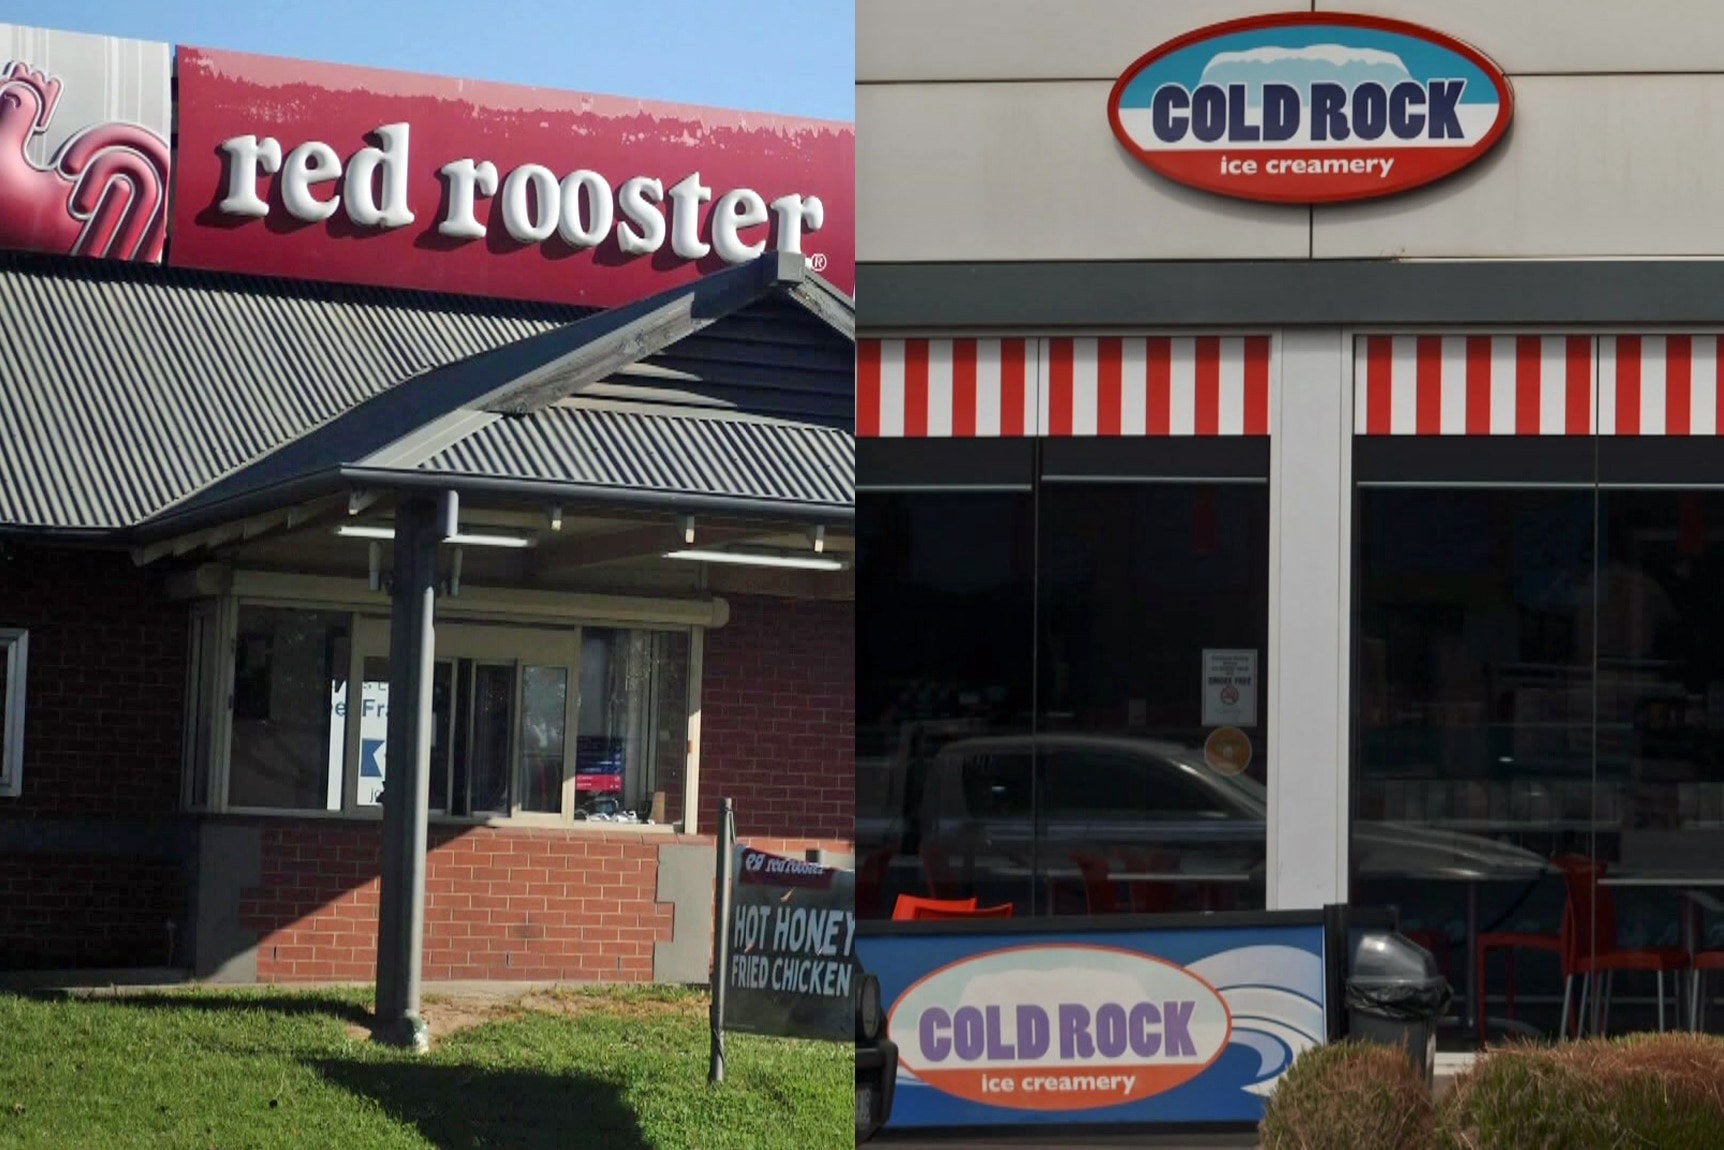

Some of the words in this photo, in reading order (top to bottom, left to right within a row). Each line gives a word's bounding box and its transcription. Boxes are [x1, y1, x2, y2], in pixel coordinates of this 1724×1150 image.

[1151, 82, 1301, 143] COLD
[1310, 79, 1467, 142] ROCK
[219, 122, 415, 228] red
[438, 157, 824, 263] rooster
[1220, 156, 1258, 175] ice
[1265, 157, 1395, 178] creamery
[734, 904, 771, 951] HOT
[773, 905, 855, 957] HONEY
[732, 954, 769, 989] FRIED
[772, 957, 852, 998] CHICKEN
[918, 1004, 1051, 1062] COLD
[1058, 1001, 1198, 1060] ROCK
[981, 1073, 1015, 1092] ice
[1022, 1074, 1136, 1095] creamery
